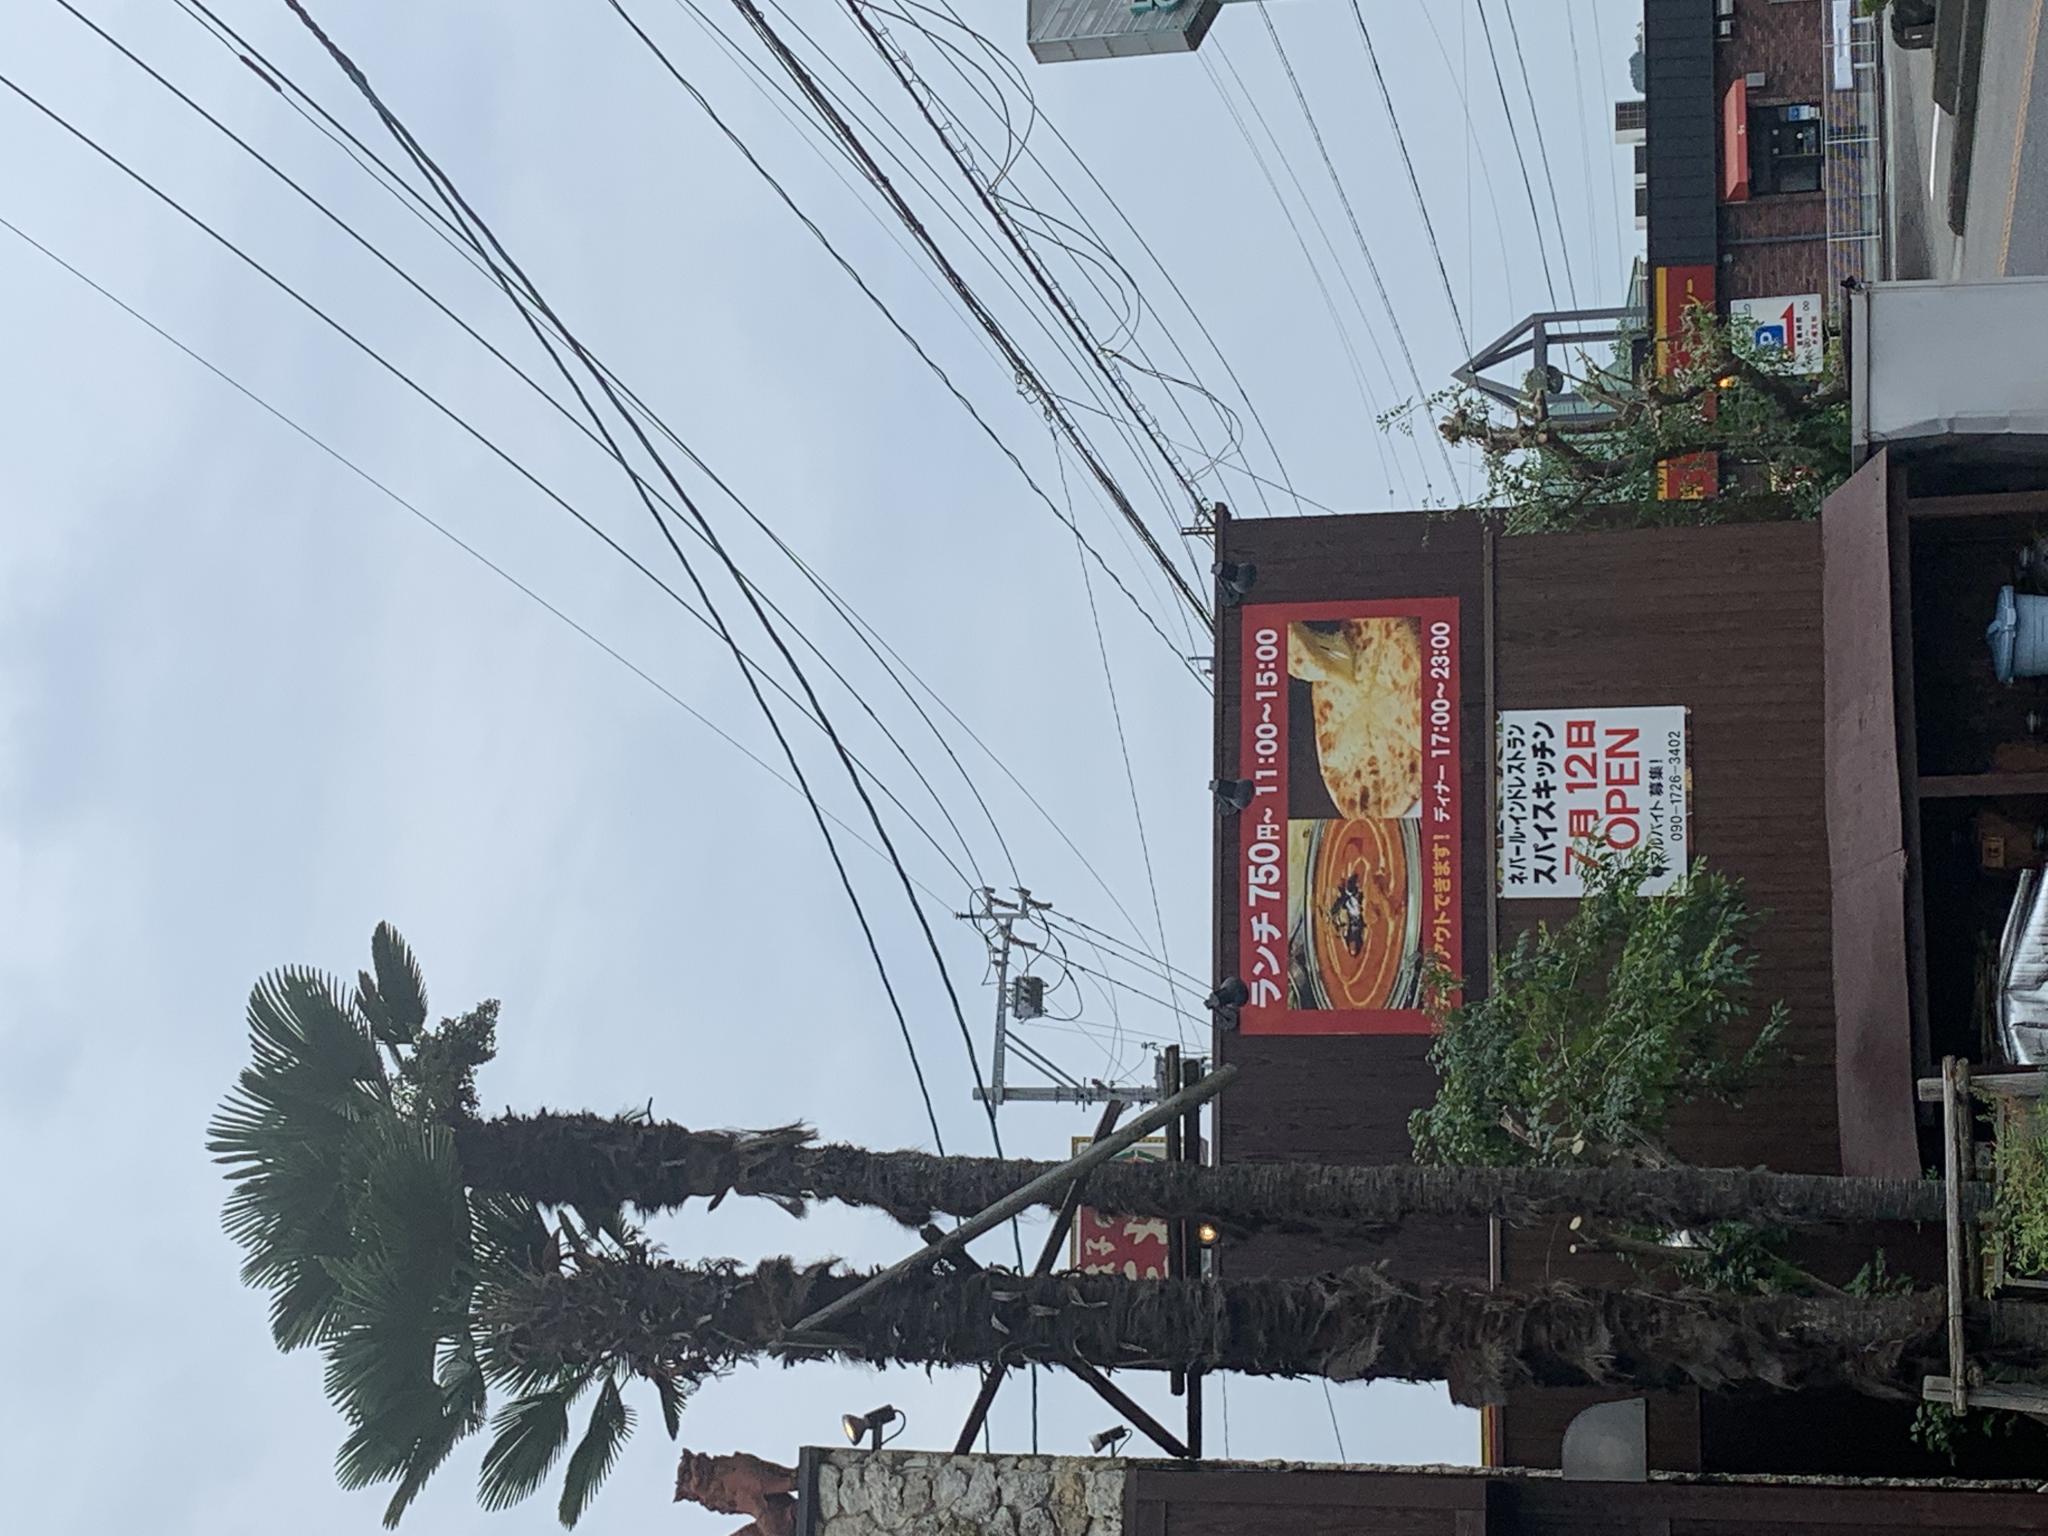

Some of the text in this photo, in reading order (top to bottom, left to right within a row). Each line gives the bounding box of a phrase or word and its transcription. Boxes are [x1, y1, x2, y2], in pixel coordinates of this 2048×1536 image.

[1434, 764, 1451, 823] ディナー
[1530, 720, 1558, 885] スパイスキッチン
[1604, 728, 1640, 850] OPEN
[1667, 730, 1683, 842] 090-1726-3402
[1251, 913, 1281, 1007] ランチ
